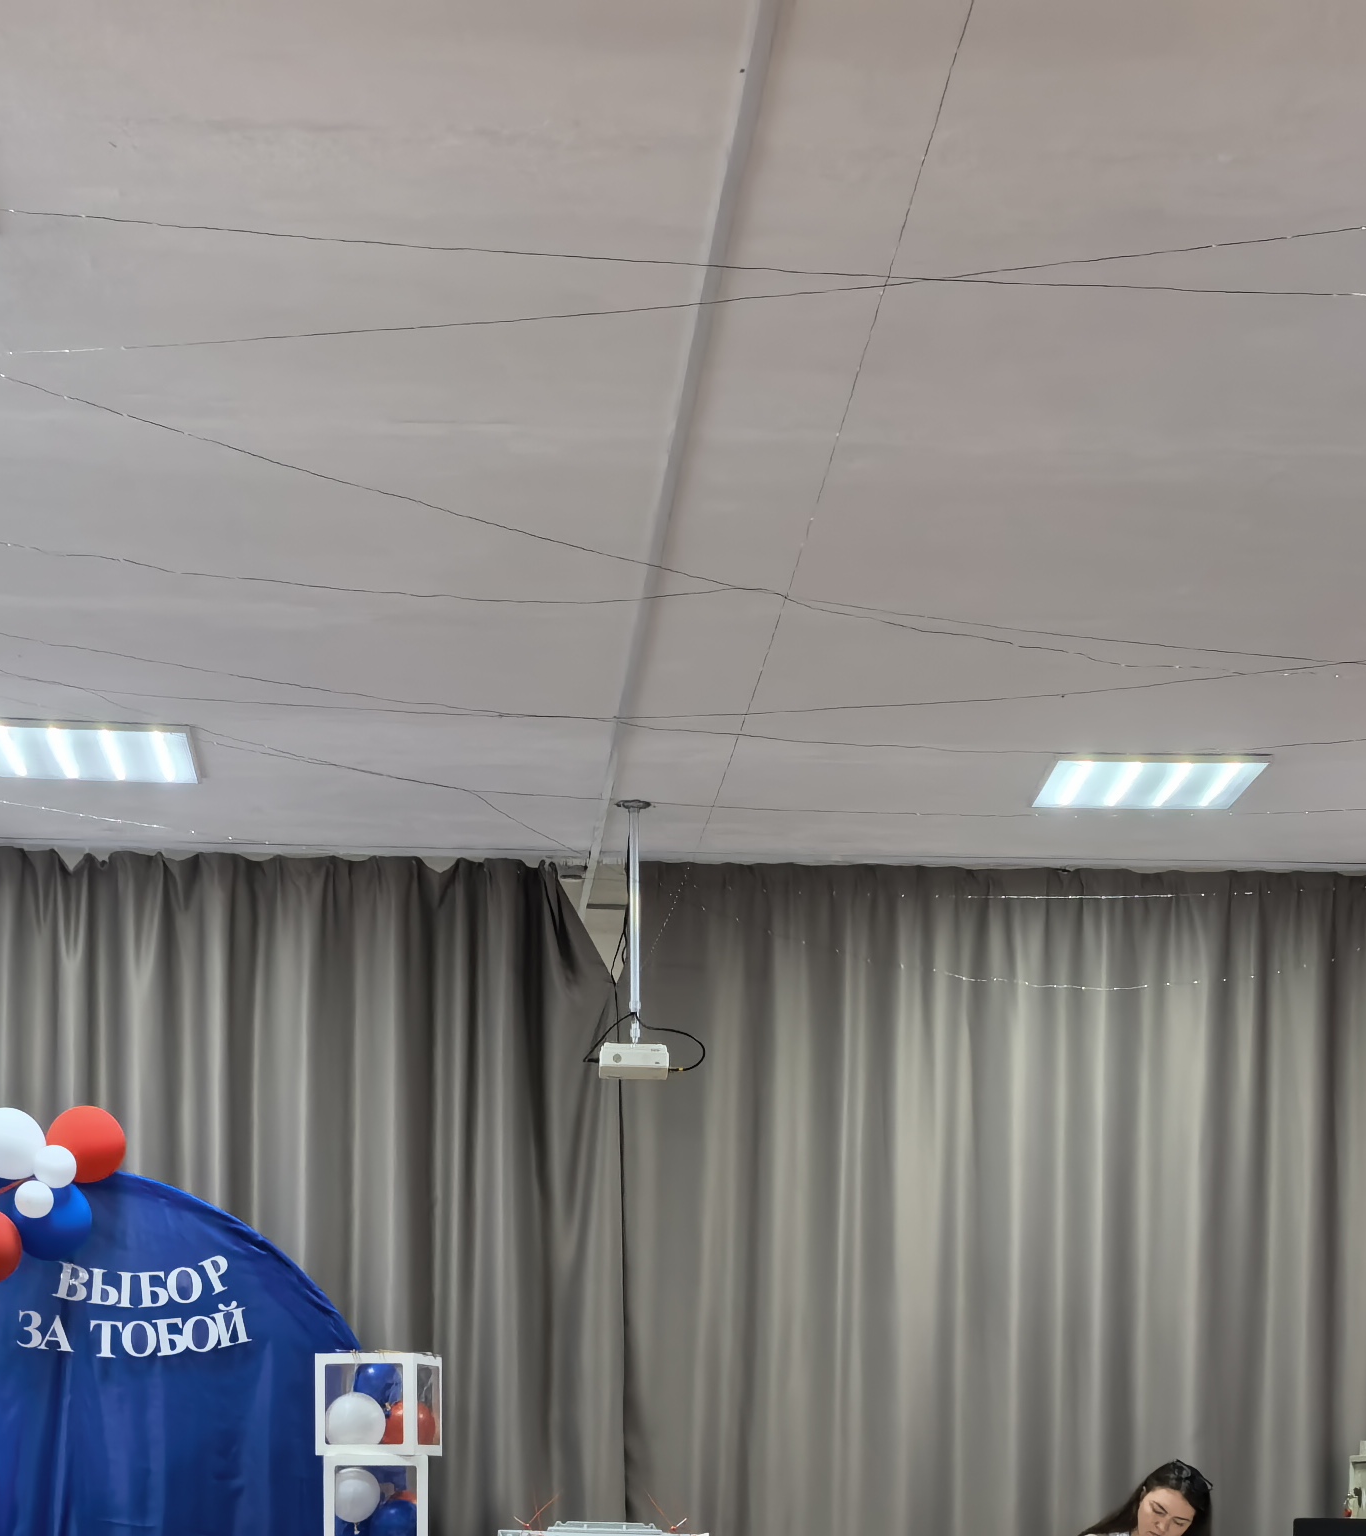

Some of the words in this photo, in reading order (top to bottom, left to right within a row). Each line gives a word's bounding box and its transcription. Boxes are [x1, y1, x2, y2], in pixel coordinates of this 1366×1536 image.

[52, 1255, 229, 1309] ВЫБОР
[17, 1310, 75, 1352] ЗА
[90, 1300, 252, 1358] ТОБОЙ
